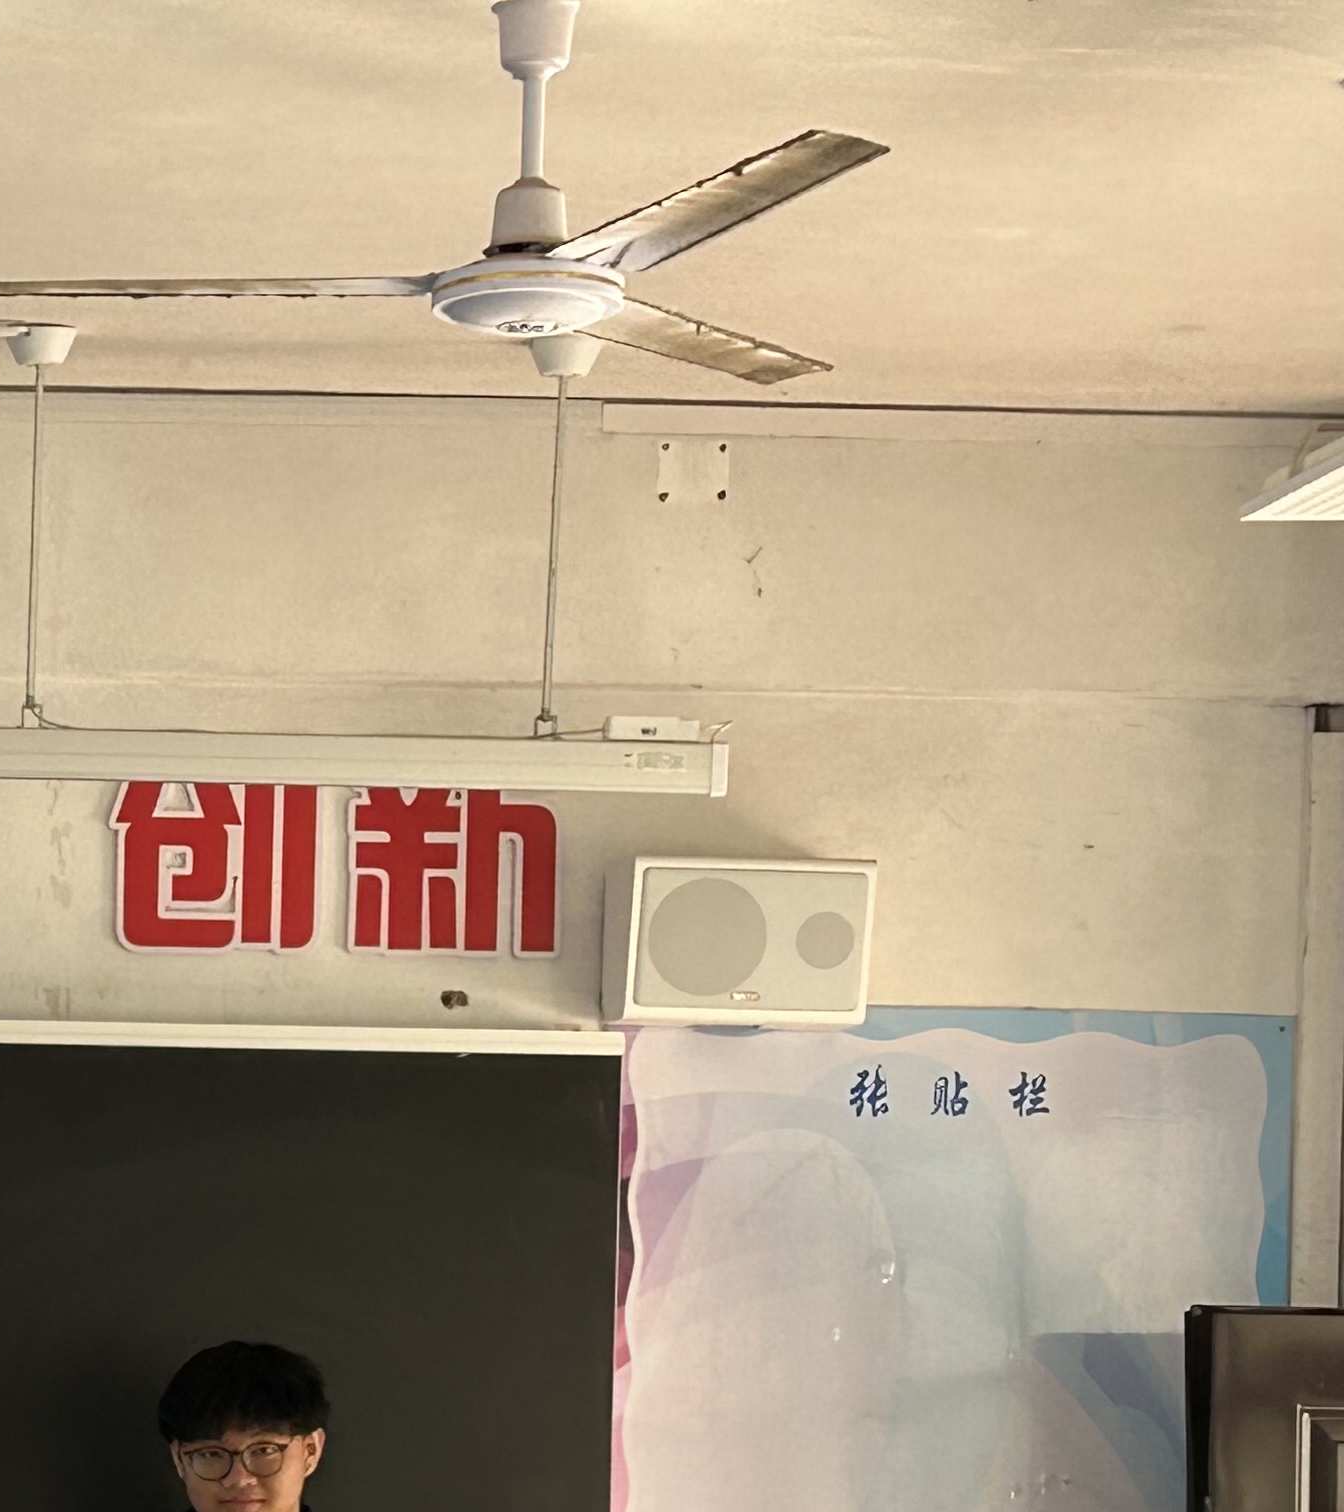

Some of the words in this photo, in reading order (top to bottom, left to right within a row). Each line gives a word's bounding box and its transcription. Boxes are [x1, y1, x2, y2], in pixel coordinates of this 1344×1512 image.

[109, 781, 561, 958] 创新
[849, 1064, 1051, 1117] 张贴栏
